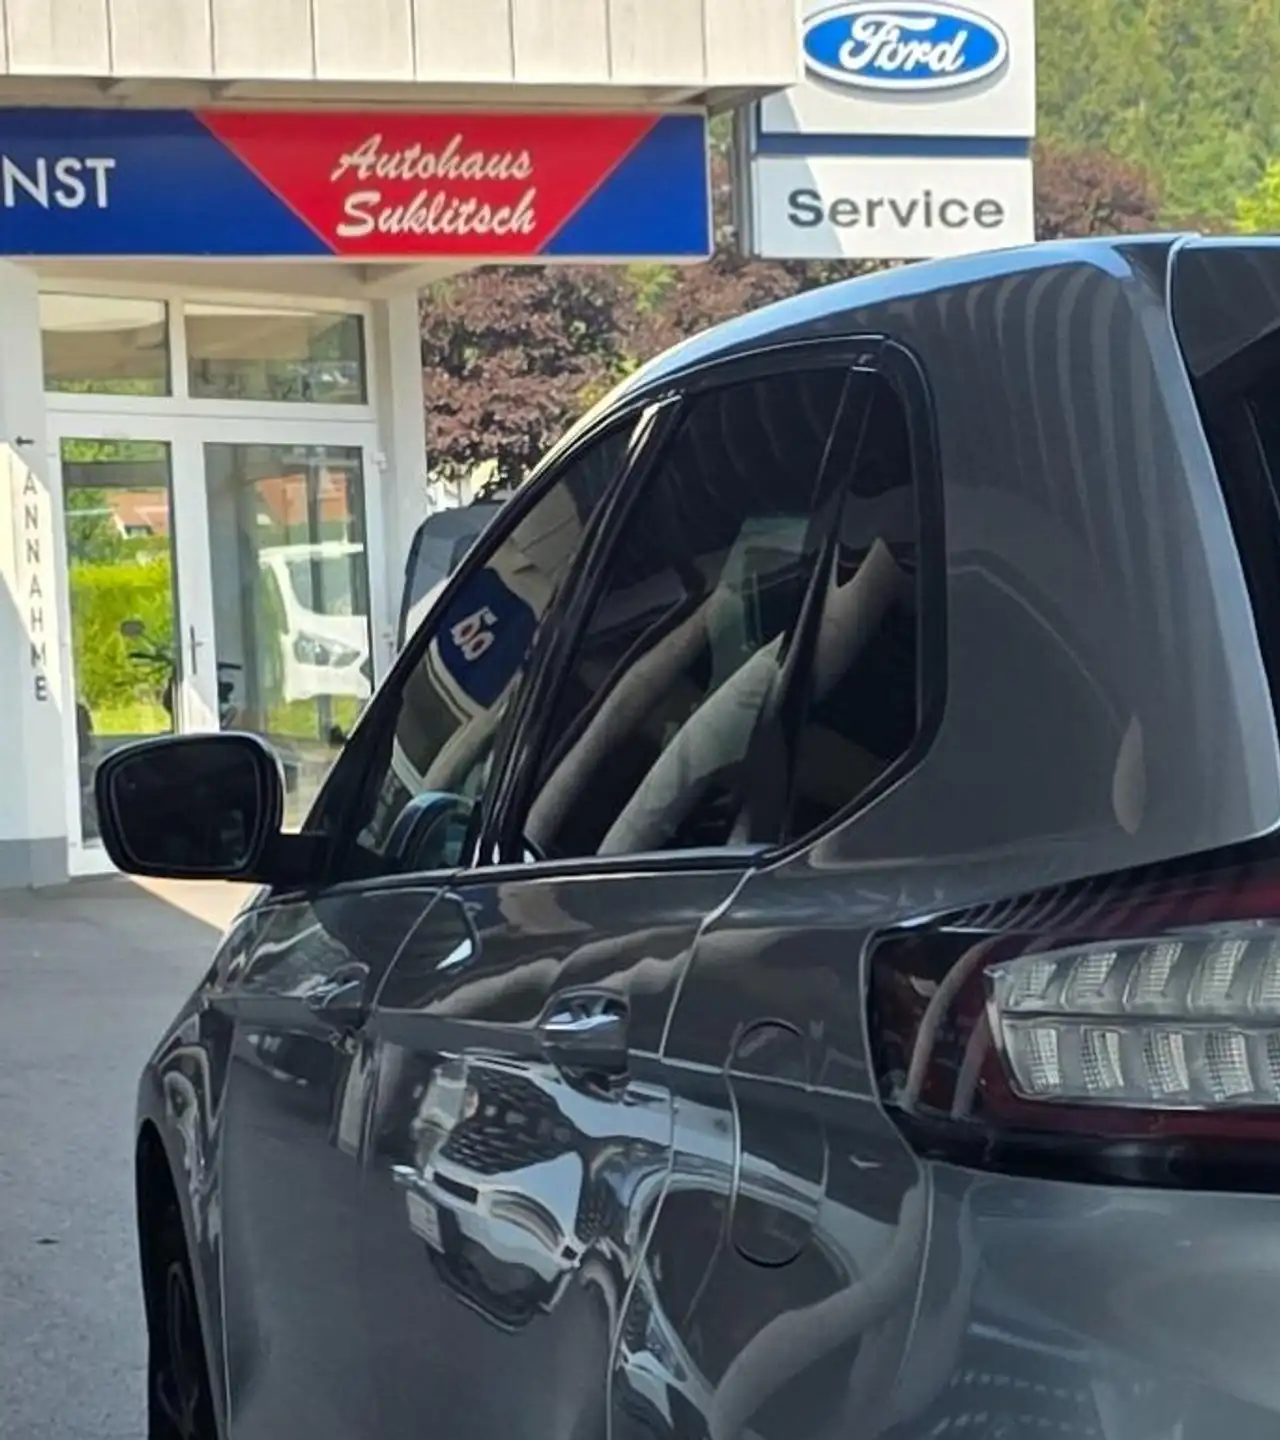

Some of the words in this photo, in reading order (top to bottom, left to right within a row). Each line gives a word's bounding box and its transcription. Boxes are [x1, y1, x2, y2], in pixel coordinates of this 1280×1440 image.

[839, 14, 967, 71] Ford
[331, 133, 533, 181] Autohaus
[336, 187, 537, 237] Suklitsch
[787, 188, 1005, 229] Service
[23, 472, 48, 701] ANNAHME
